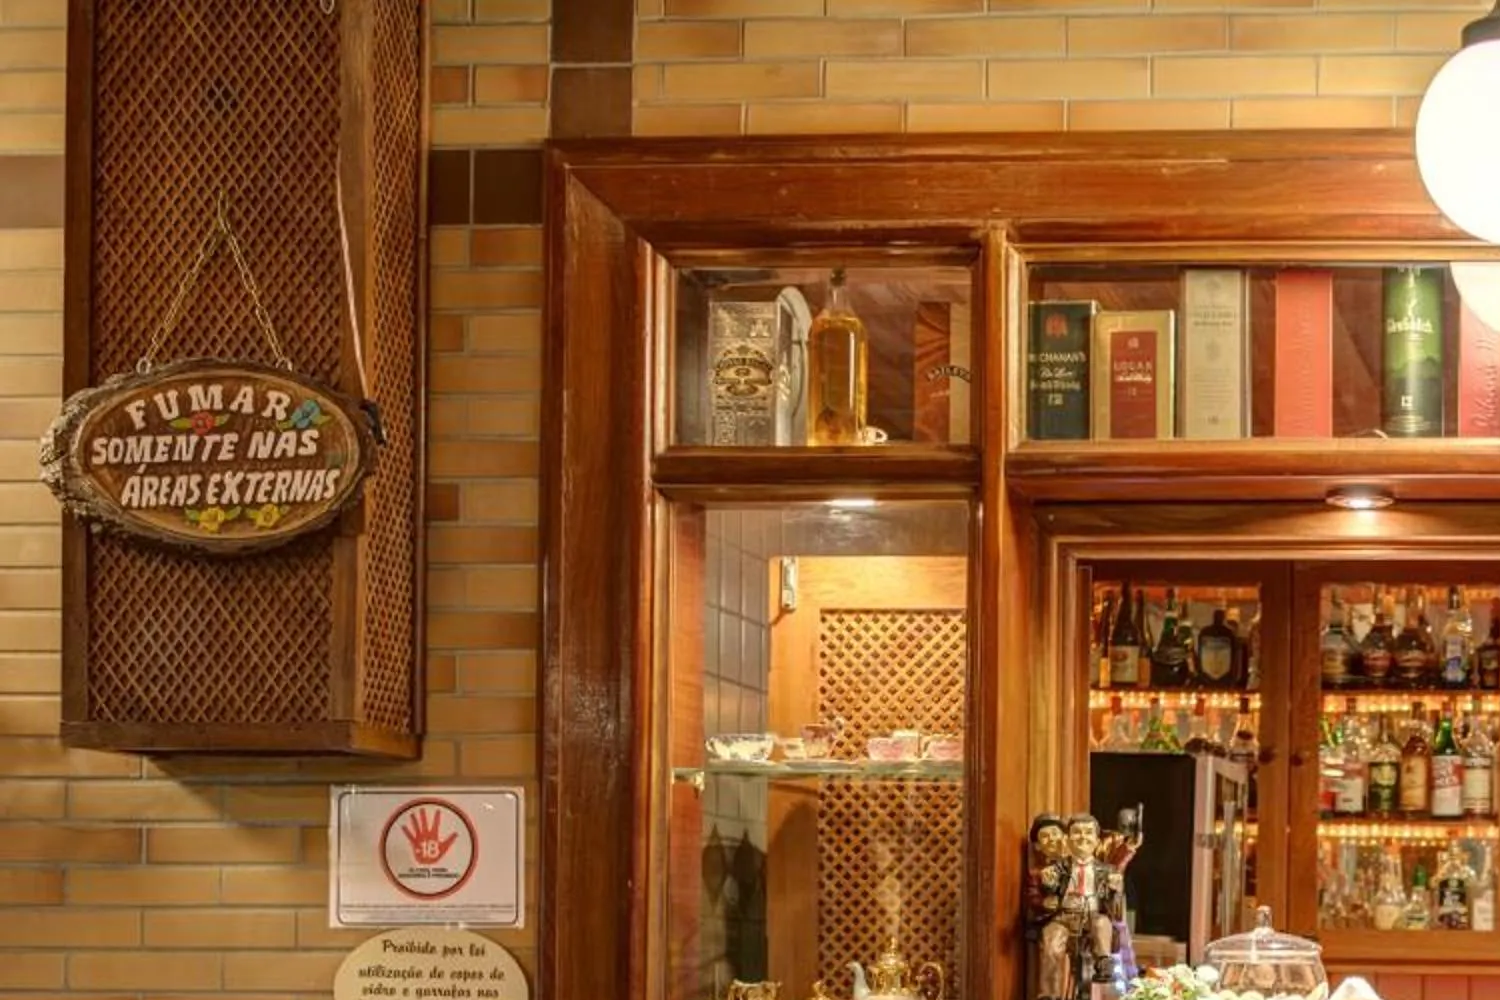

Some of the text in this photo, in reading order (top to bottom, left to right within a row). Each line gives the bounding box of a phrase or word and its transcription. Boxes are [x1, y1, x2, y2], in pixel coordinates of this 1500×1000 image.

[125, 384, 292, 430] FUMAR
[92, 430, 319, 466] SOMENTE NAS
[121, 462, 341, 507] ÁREAS EXTERNAS
[382, 939, 486, 958] Proibido por lei
[358, 965, 423, 981] utilização
[429, 966, 444, 979] de
[489, 967, 505, 981] de
[362, 983, 499, 999] vidro e garrafas nas
